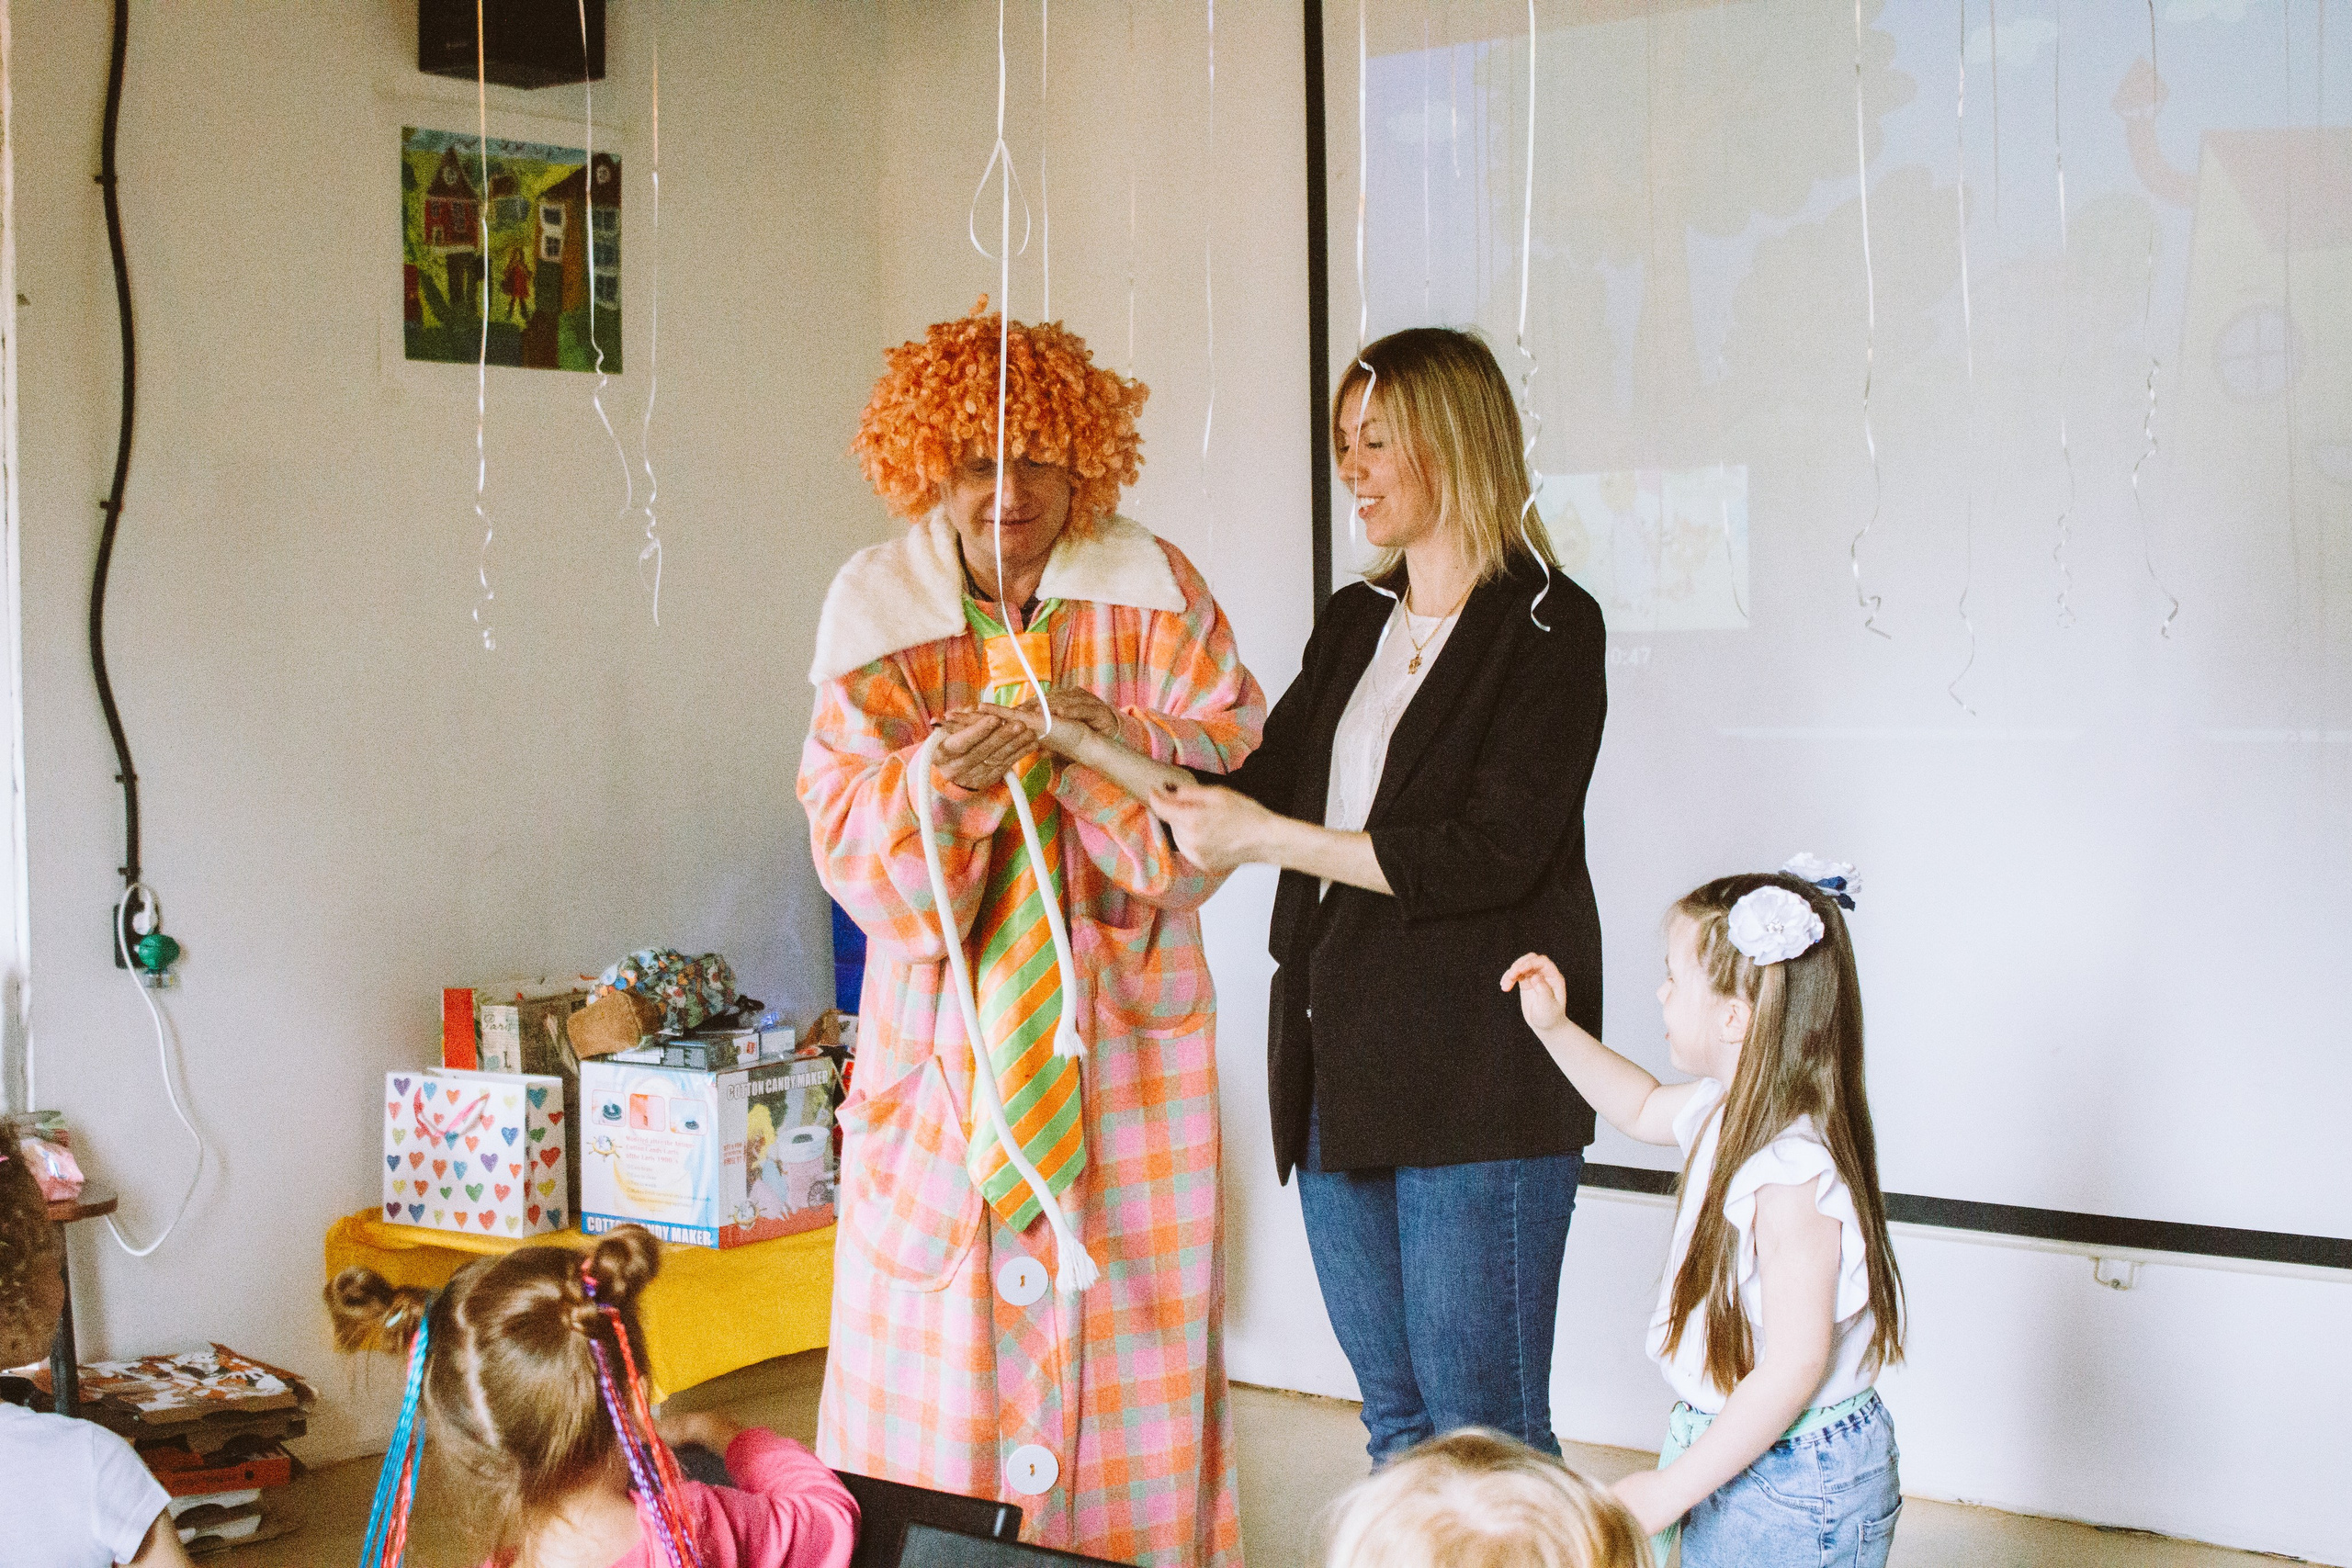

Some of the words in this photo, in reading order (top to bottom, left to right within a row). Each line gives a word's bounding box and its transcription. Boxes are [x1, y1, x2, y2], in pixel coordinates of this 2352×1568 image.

[726, 1080, 764, 1100] COTTON
[765, 1075, 797, 1094] CANDY
[797, 1069, 829, 1088] MAKER
[587, 1216, 628, 1233] COTT
[672, 1226, 712, 1246] MAKER
